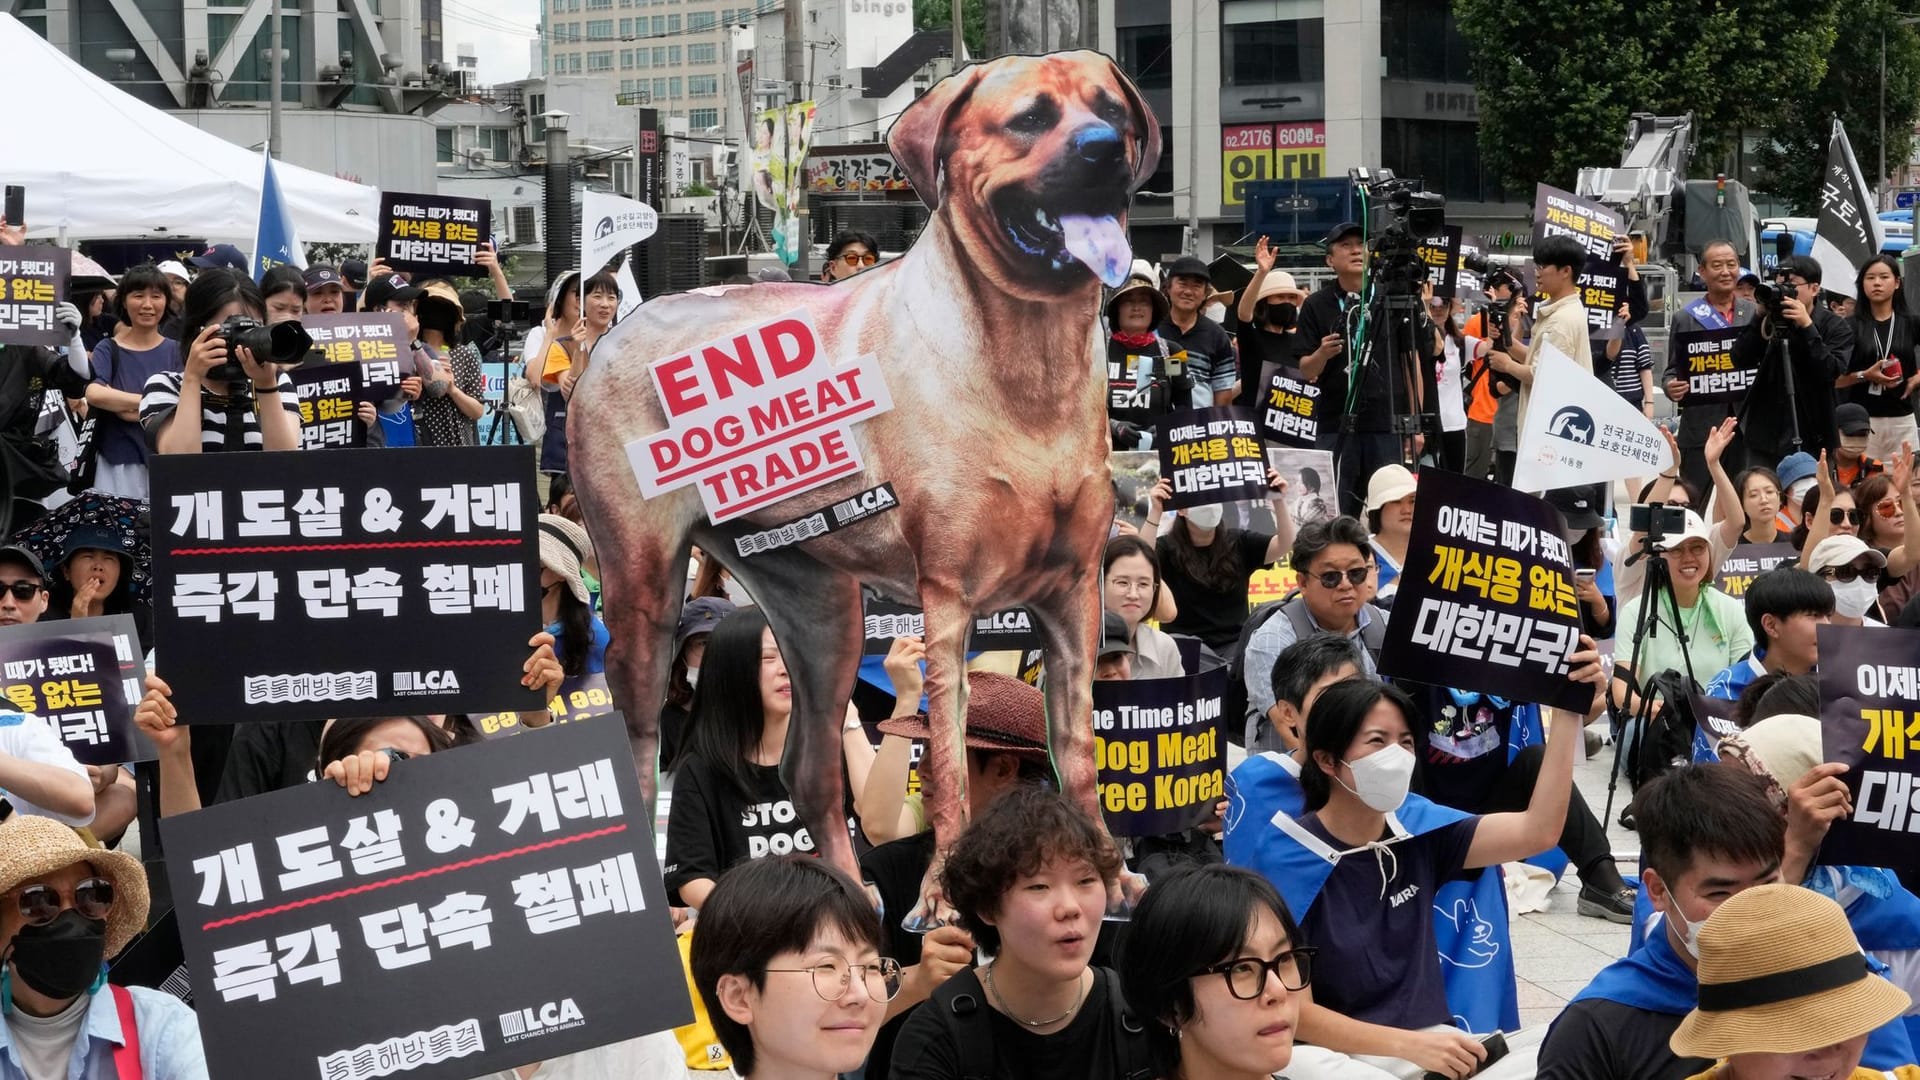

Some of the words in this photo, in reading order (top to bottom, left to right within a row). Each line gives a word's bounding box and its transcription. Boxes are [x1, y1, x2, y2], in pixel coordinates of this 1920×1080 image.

[393, 204, 426, 218] 이제는
[428, 207, 451, 220] 때가
[453, 208, 478, 222] 됐다!
[392, 219, 441, 240] 개식용
[445, 222, 478, 242] 없는
[390, 239, 477, 265] 대한민국!
[21, 260, 54, 276] 됐다!
[11, 278, 55, 301] 없는
[1585, 288, 1615, 308] 없는
[334, 325, 361, 339] 때가
[362, 324, 393, 337] 됐다!
[358, 340, 397, 360] 없는
[1688, 341, 1720, 354] 이제는
[654, 319, 816, 417] END
[296, 382, 321, 398] 때가
[322, 377, 351, 395] 됐다!
[1272, 375, 1302, 394] 이제는
[317, 397, 353, 420] 없는
[1269, 389, 1313, 417] 개식용
[649, 415, 745, 473] DOG
[747, 367, 862, 437] MEAT
[1169, 423, 1206, 443] 이제는
[1208, 420, 1234, 435] 때가
[1171, 438, 1228, 466] 개식용
[1231, 437, 1262, 459] 없는
[1602, 423, 1661, 452] 전국길고양이
[1599, 438, 1659, 466] 보호단체연합
[703, 429, 849, 506] TRADE
[1173, 460, 1267, 494] 대한민국!
[170, 490, 224, 541] 개
[238, 487, 345, 538] 도살
[361, 487, 404, 534] &
[421, 482, 522, 533] 거래
[852, 486, 894, 515] LCA
[1437, 504, 1498, 547] 이제는
[1501, 520, 1538, 556] 때가
[1540, 528, 1570, 568] 됐다!
[172, 570, 279, 624] 즉각
[297, 566, 404, 620] 단속
[422, 562, 525, 615] 철폐
[1427, 544, 1523, 605] 개식용
[1528, 565, 1579, 618] 없는
[993, 611, 1032, 629] LCA
[1410, 597, 1580, 676] 대한민국!
[4, 658, 46, 680] 때가
[47, 653, 96, 676] 됐다!
[413, 670, 460, 690] LCA
[41, 680, 103, 710] 없는
[249, 674, 374, 701] 동물해방물결
[1118, 705, 1174, 729] Time
[1177, 702, 1194, 726] is
[1196, 696, 1221, 722] Now
[1157, 727, 1217, 768] Meat
[1154, 769, 1223, 810] Korea
[193, 843, 265, 907] 개
[275, 808, 406, 892] 도살
[425, 798, 477, 855] &
[492, 758, 626, 836] 거래
[1389, 884, 1420, 908] KARA
[213, 925, 342, 1003] 즉각
[359, 890, 494, 971] 단속
[511, 852, 647, 936] 철폐
[523, 998, 585, 1031] LCA
[503, 1035, 520, 1044] LAST
[520, 1029, 545, 1041] CHANCE
[545, 1026, 559, 1036] FOR
[559, 1020, 587, 1033] ANIMALS
